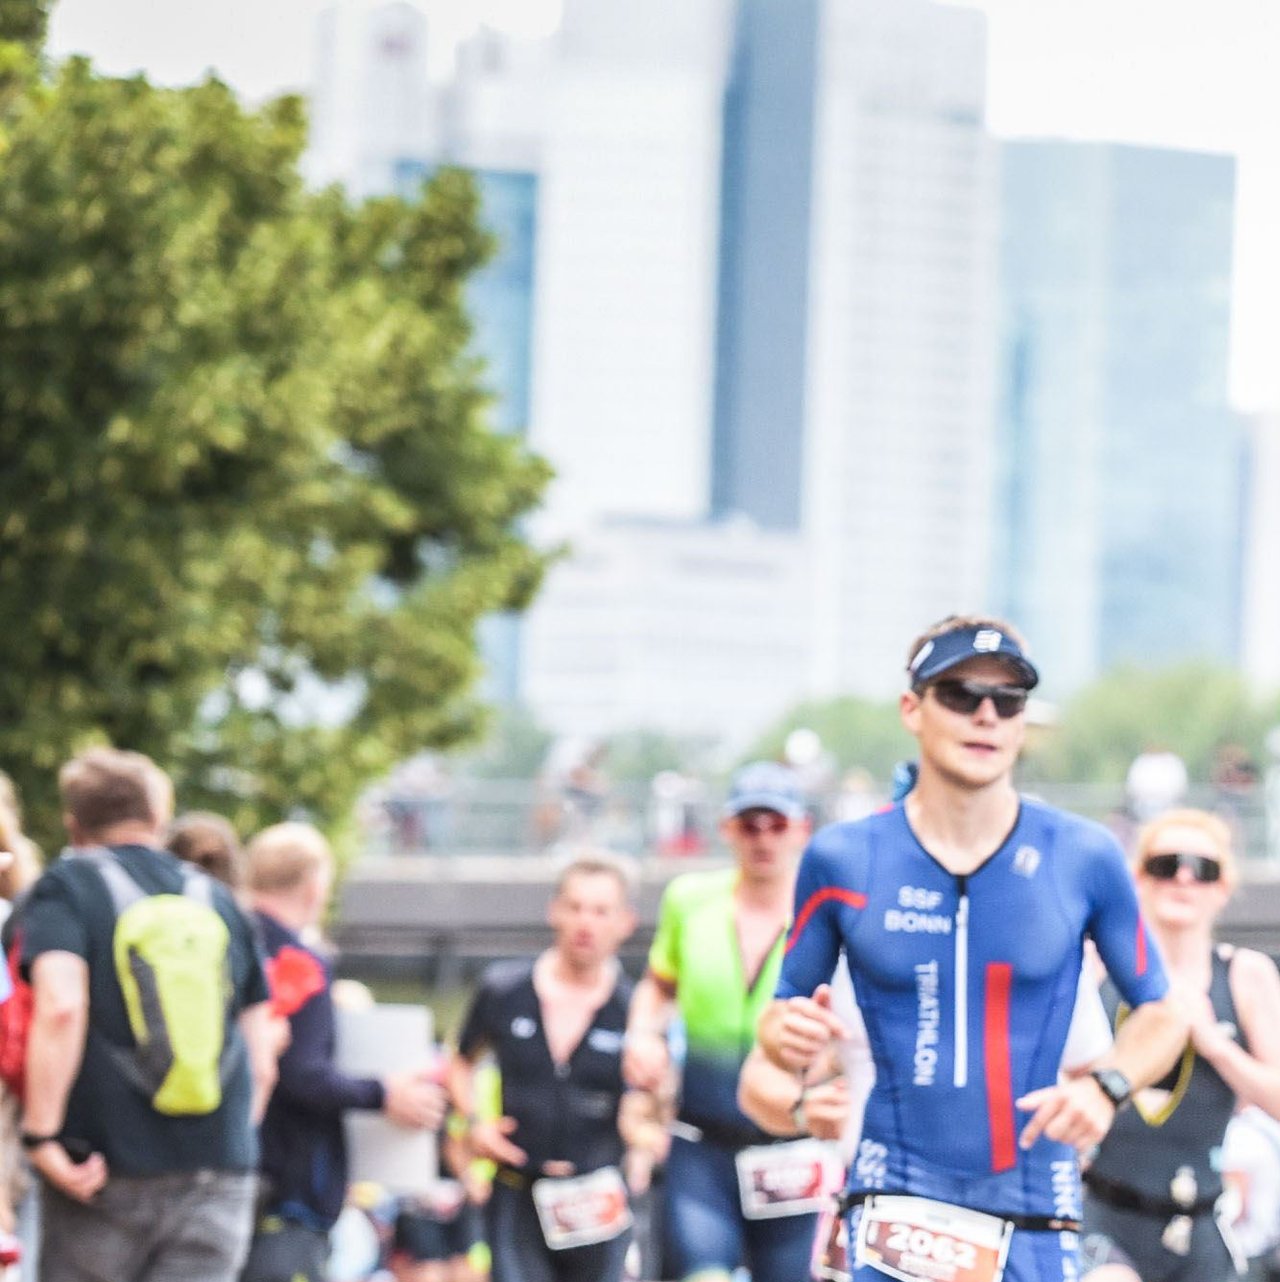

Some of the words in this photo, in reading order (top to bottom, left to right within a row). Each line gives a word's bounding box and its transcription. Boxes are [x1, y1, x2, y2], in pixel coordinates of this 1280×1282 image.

[898, 886, 943, 910] SSF
[884, 909, 952, 934] BONN
[913, 959, 940, 1086] TRIATHLON
